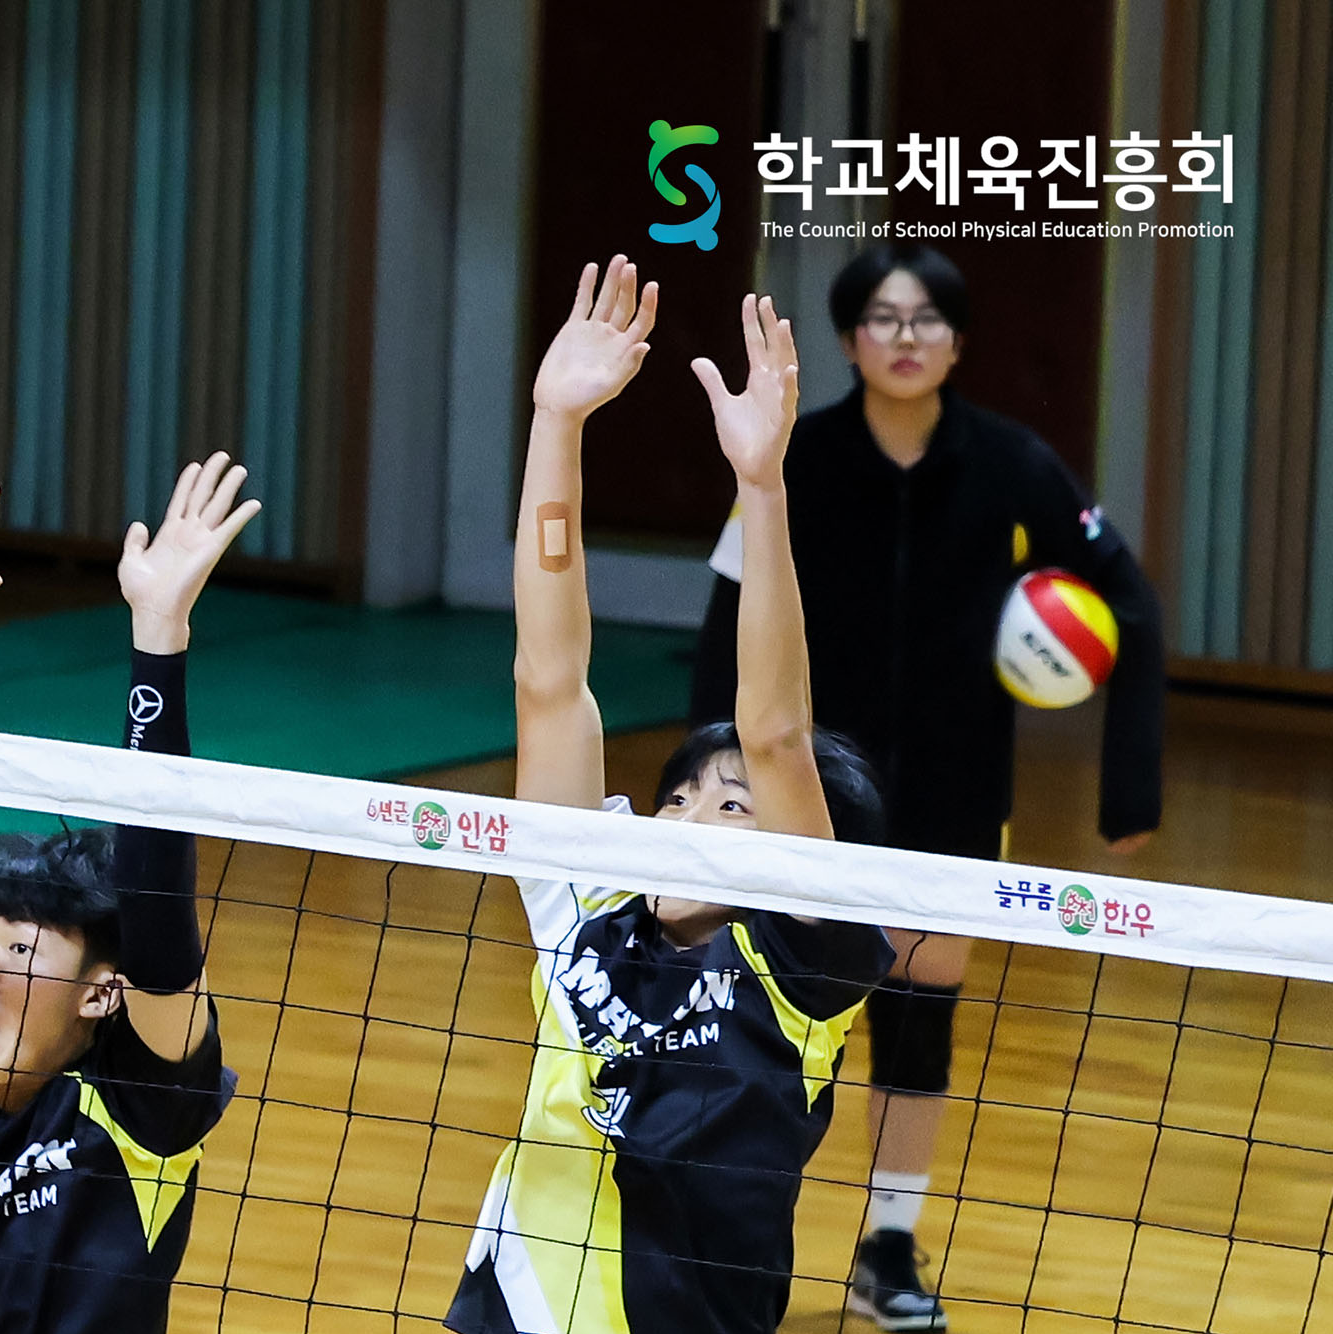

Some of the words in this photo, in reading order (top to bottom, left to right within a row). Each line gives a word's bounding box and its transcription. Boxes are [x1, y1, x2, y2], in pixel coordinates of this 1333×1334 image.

[457, 811, 510, 852] 인삼
[994, 880, 1055, 912] 늘푸름
[1103, 899, 1155, 938] 한우
